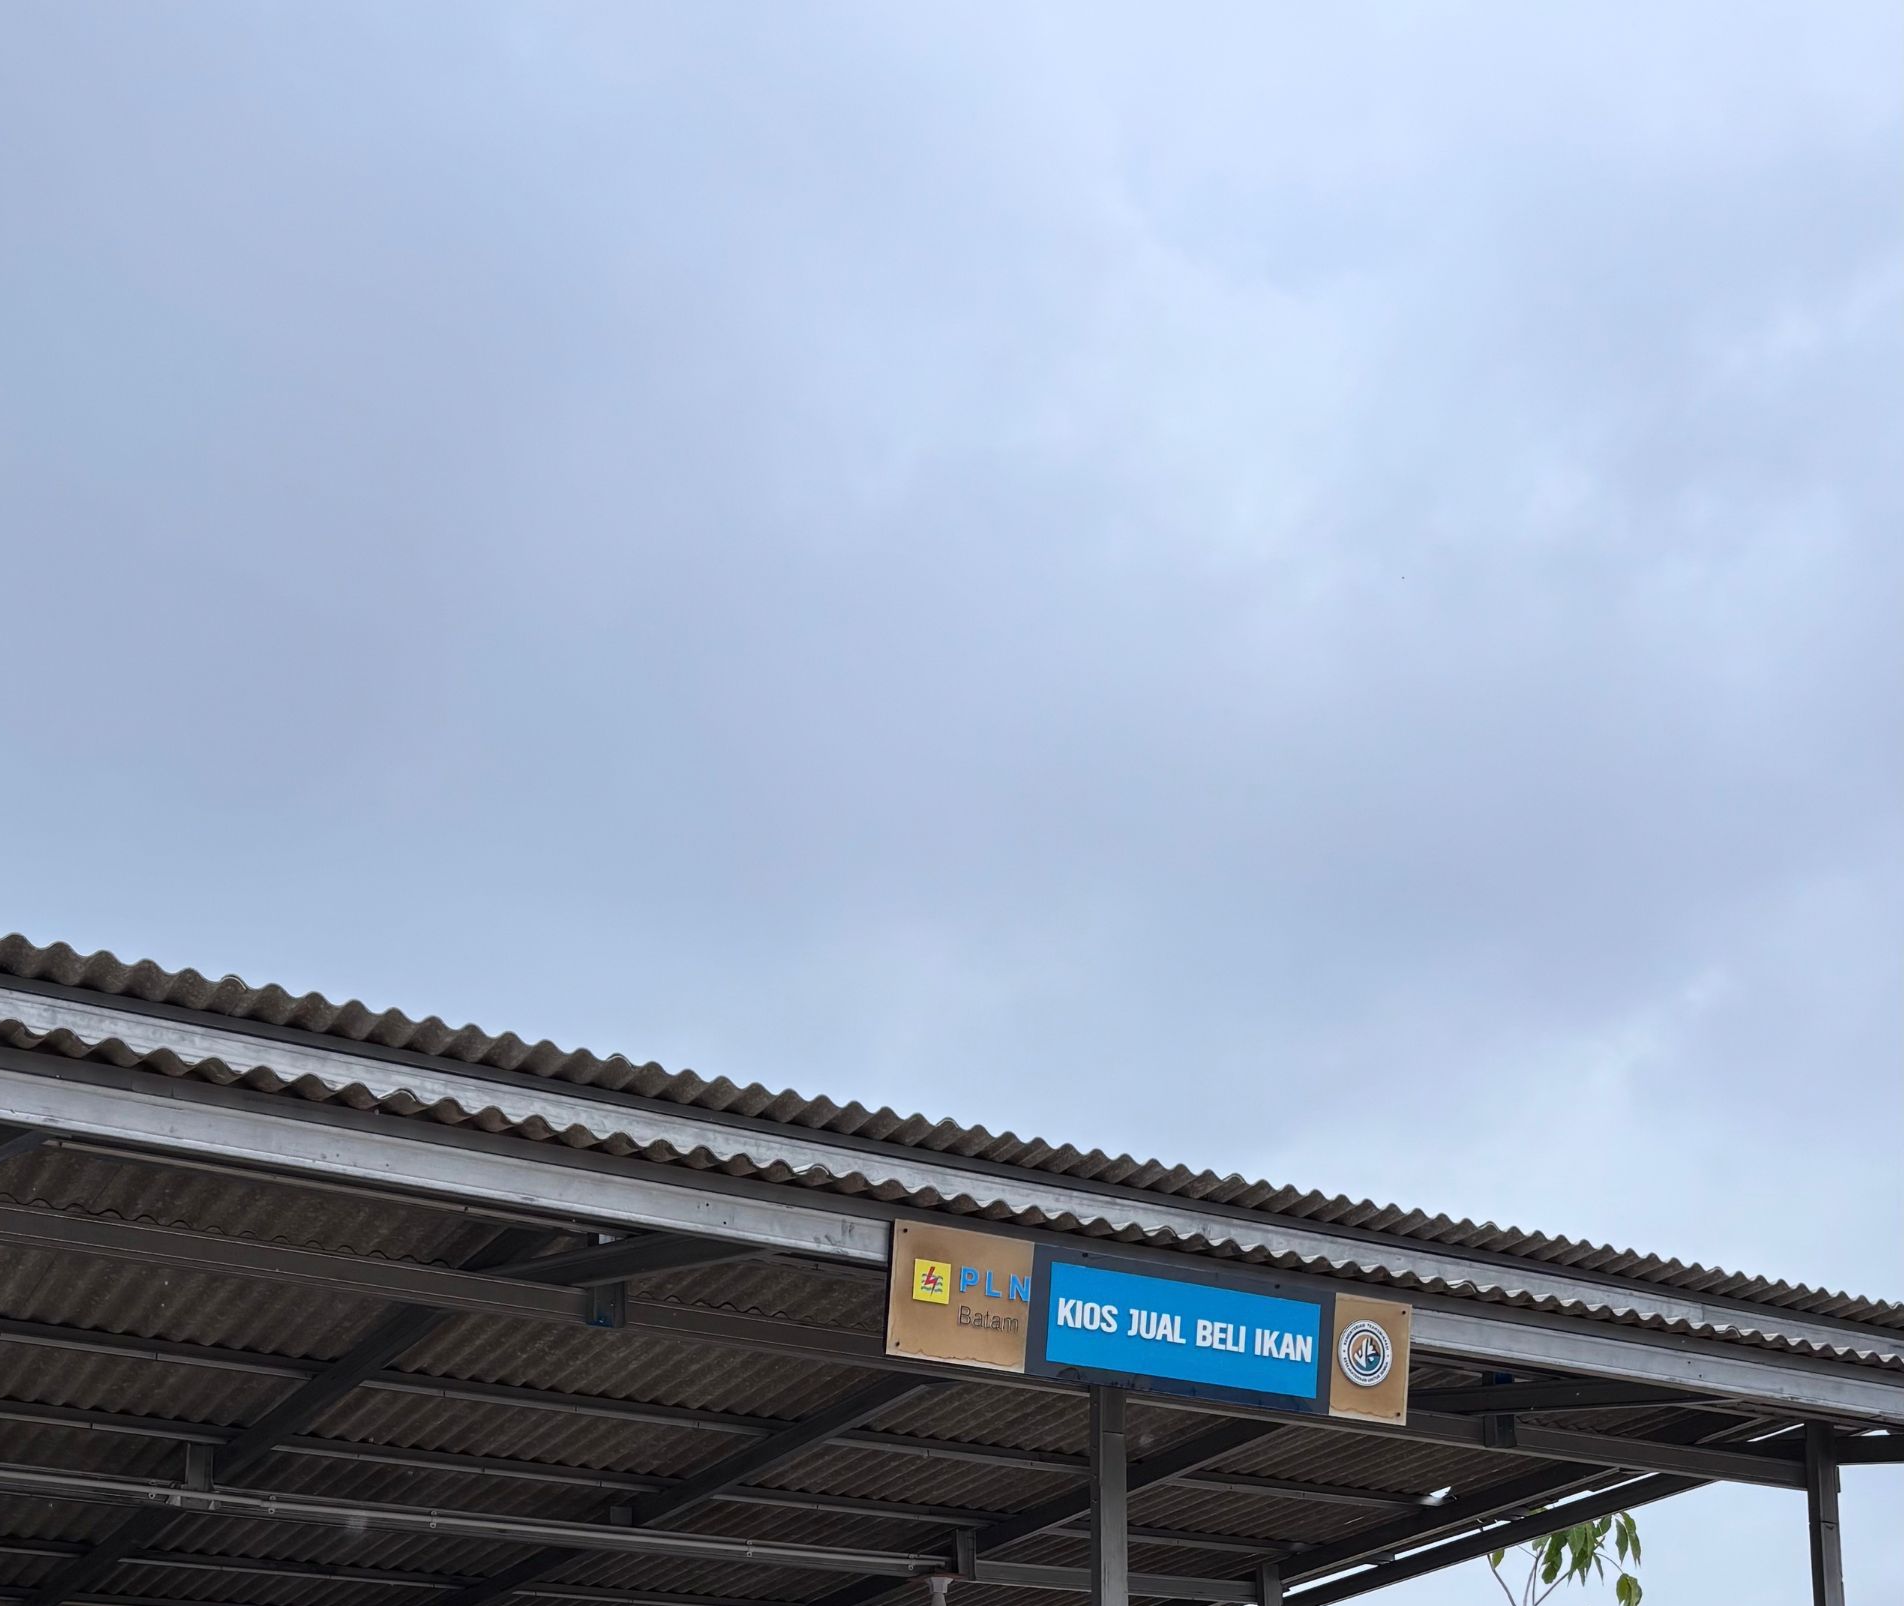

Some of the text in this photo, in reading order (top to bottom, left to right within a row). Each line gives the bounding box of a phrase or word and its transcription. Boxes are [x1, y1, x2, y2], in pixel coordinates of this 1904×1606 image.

[960, 1265, 1031, 1303] PLN
[959, 1305, 1019, 1334] Batam
[1057, 1298, 1313, 1363] KIOS JUAL BELI IKAN
